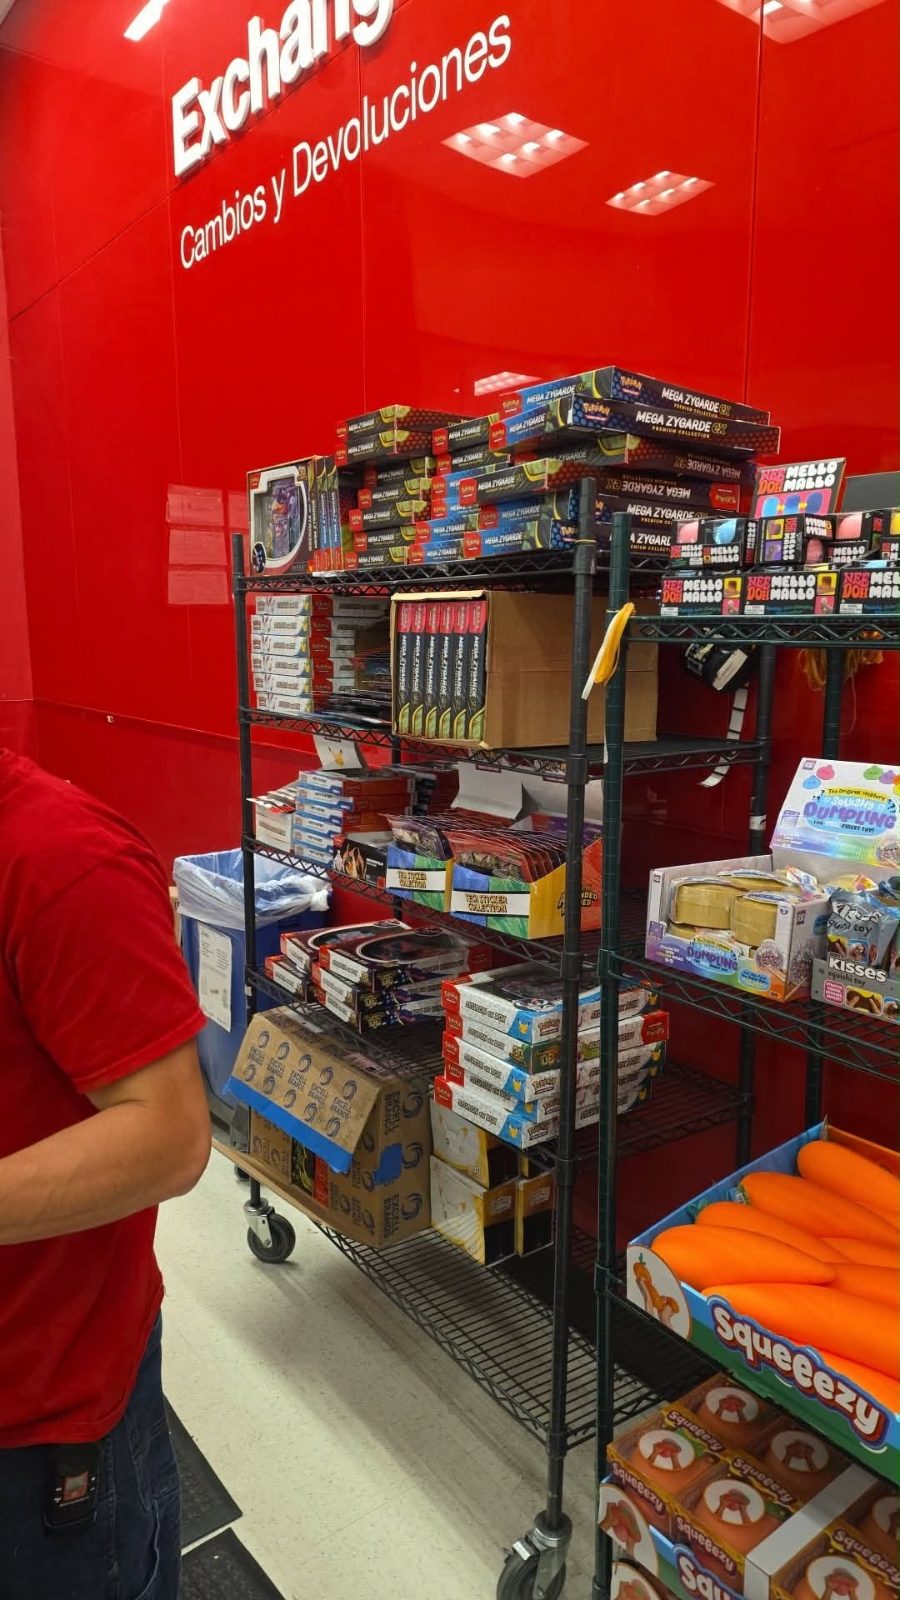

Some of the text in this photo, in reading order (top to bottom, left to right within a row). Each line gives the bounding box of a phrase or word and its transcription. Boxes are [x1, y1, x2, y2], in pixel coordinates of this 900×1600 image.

[180, 13, 512, 269] Cambios y Devoluciones
[545, 385, 576, 400] ZYGARDE
[661, 388, 684, 403] MEGA
[684, 394, 719, 413] ZYGARDE
[636, 411, 665, 424] MEGA
[665, 415, 711, 432] ZYGARDE
[786, 461, 838, 479] MELLO
[622, 480, 666, 496] ZYGARDE
[783, 474, 835, 492] MALLO
[666, 486, 691, 499] MEGA
[627, 504, 653, 516] MEGA
[654, 507, 695, 520] ZYGARDE
[637, 533, 671, 546] ZYGAR
[711, 545, 739, 555] MELLO
[834, 545, 865, 557] MELLO
[711, 554, 740, 563] MALLO
[683, 579, 723, 591] MELLO
[771, 574, 816, 588] MELLO
[870, 571, 900, 585] MEL
[683, 591, 722, 603] MALLO
[770, 587, 815, 601] MALLO
[869, 585, 900, 599] MAL
[803, 801, 897, 829] DUMPLING
[468, 902, 508, 913] COLLECTION
